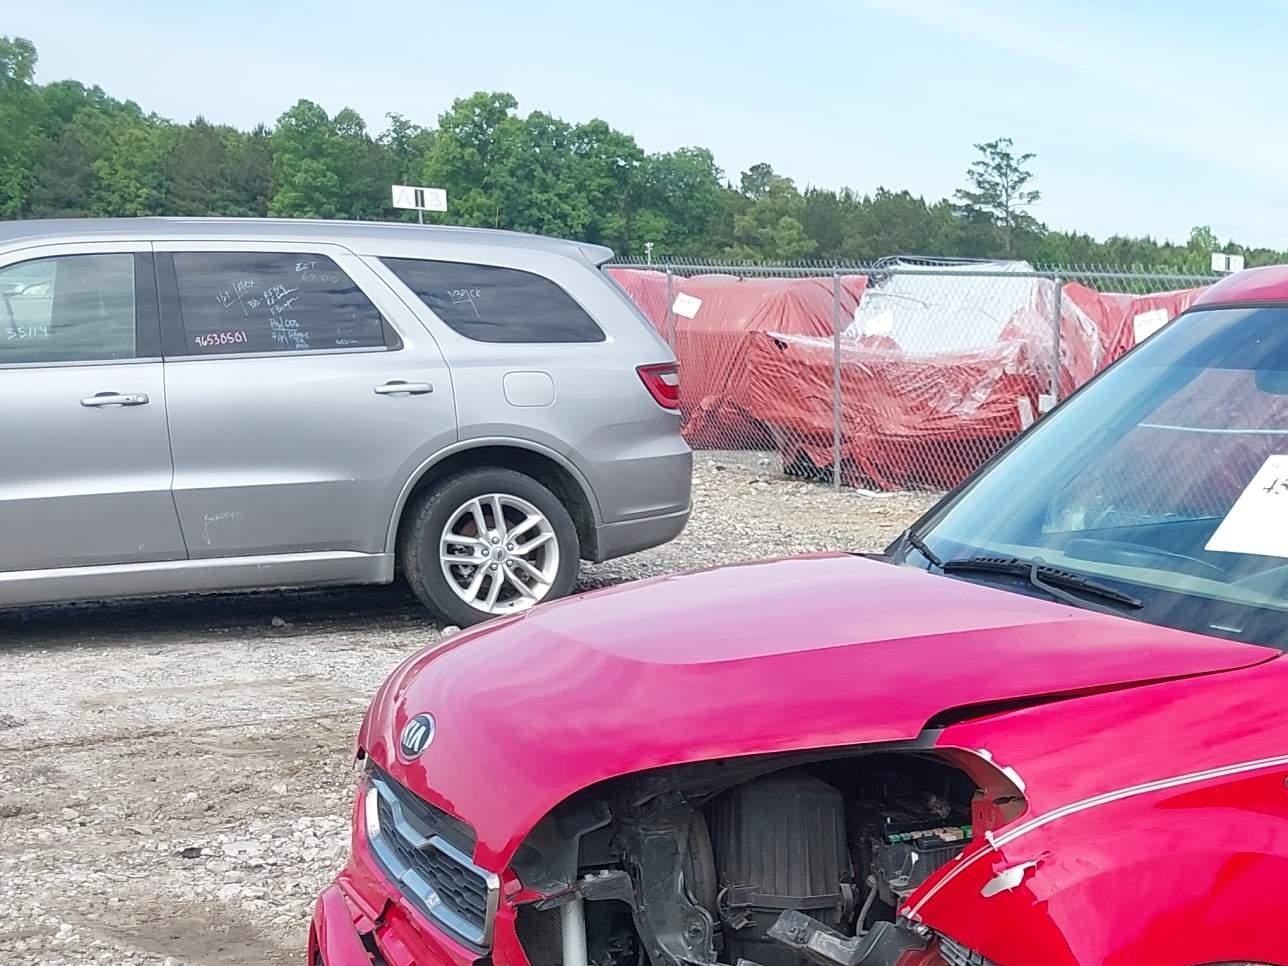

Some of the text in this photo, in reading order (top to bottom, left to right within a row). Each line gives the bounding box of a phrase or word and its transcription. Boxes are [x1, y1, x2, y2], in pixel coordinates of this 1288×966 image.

[397, 189, 442, 208] A B
[402, 719, 426, 752] KIA
